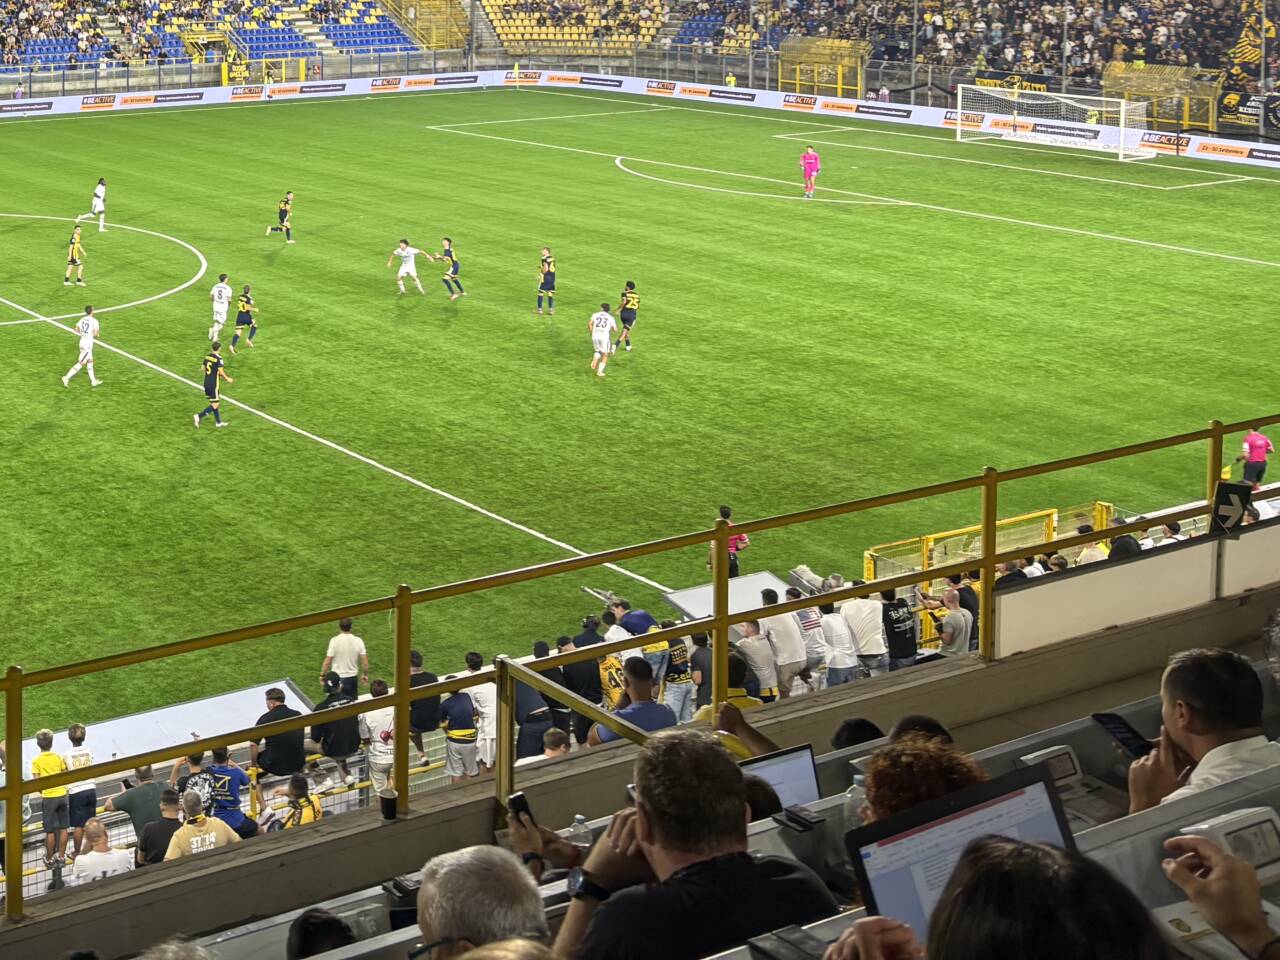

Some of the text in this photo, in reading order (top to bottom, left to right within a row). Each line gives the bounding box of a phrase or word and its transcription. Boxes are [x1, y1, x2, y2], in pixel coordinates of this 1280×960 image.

[217, 289, 223, 301] 8
[625, 297, 640, 310] 25
[595, 316, 608, 329] 23
[206, 361, 212, 375] 5
